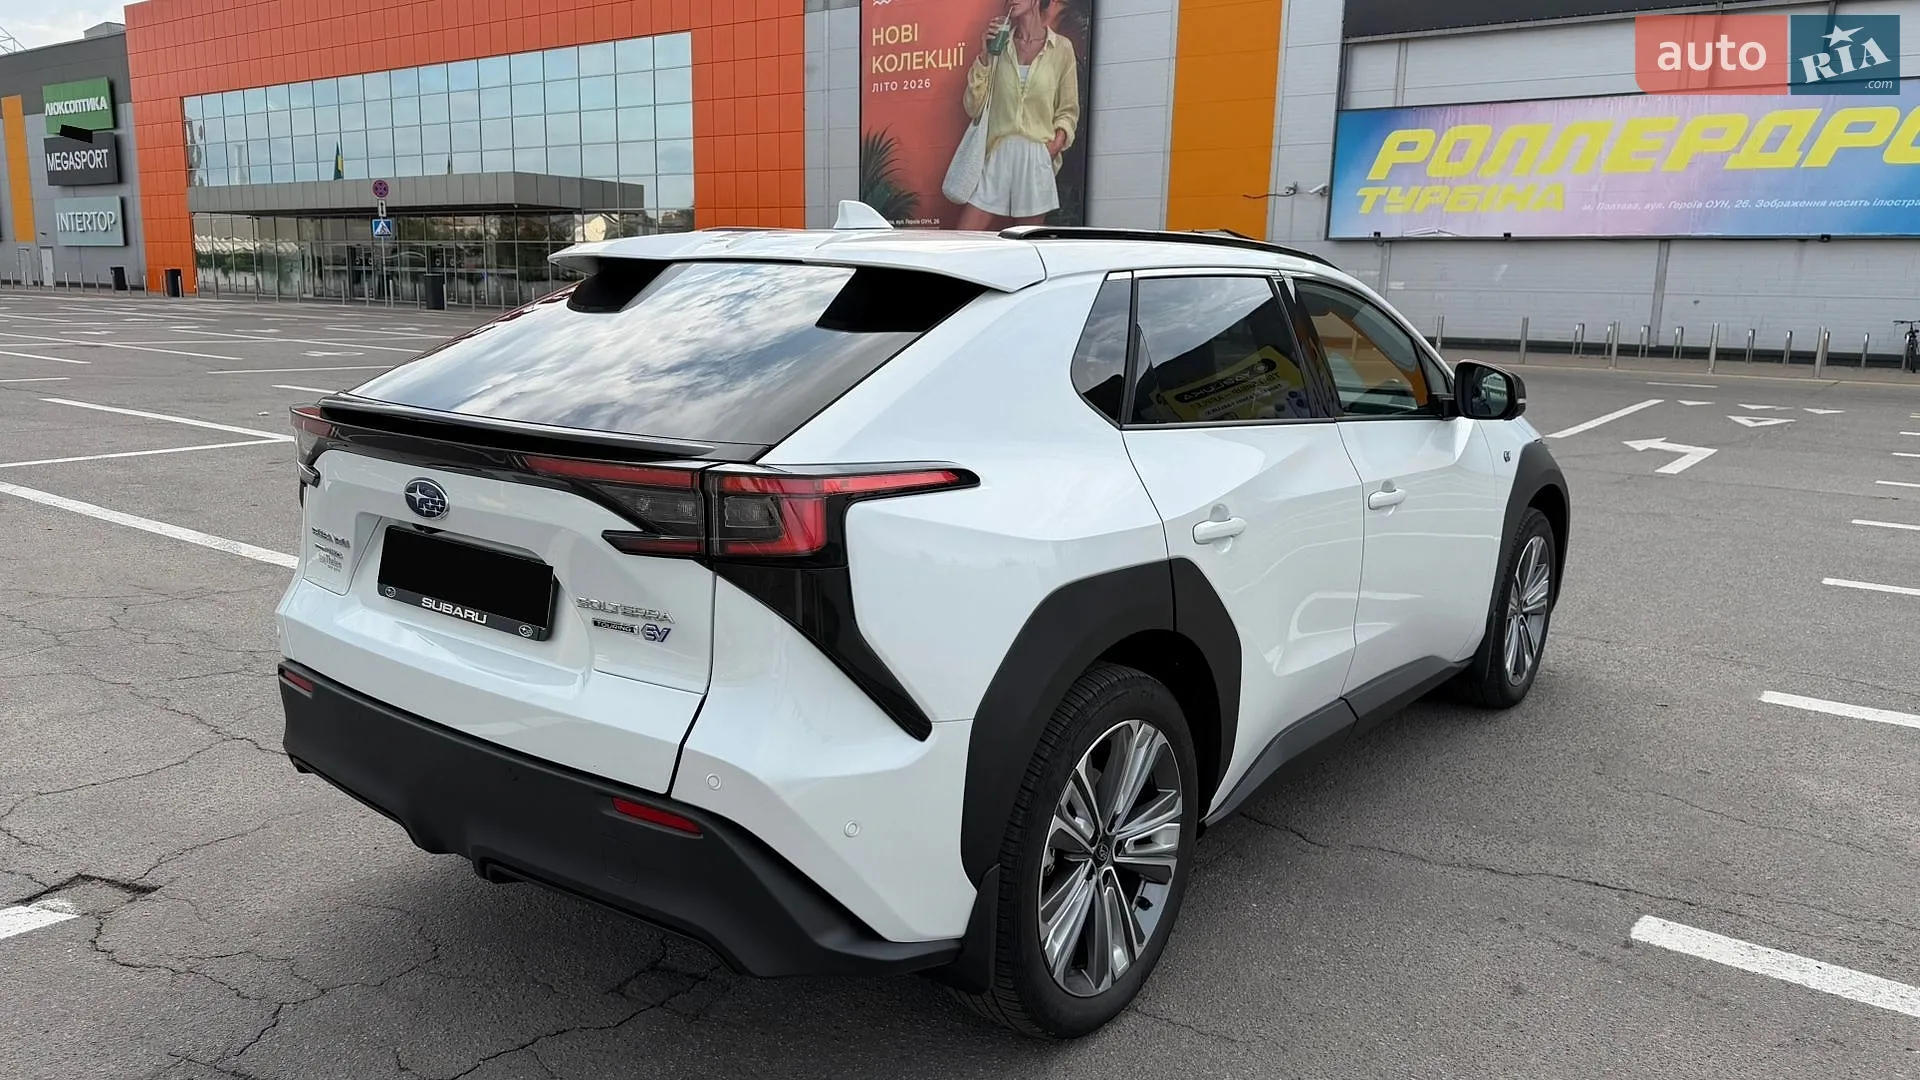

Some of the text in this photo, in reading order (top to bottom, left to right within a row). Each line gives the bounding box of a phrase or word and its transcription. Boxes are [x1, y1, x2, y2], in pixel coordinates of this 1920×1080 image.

[872, 23, 919, 46] НОВІ
[872, 42, 966, 74] КОЛЕКЦІЇ
[872, 78, 931, 93] ЛІТО 2026
[45, 96, 108, 116] ЛЮКСОПТИКА
[47, 149, 109, 172] MEGASPORT
[1356, 182, 1566, 215] ТУРБІНА
[1705, 199, 1731, 210] ОУН,
[1755, 199, 1826, 209] Зображення
[1828, 199, 1870, 208] носить
[56, 210, 116, 233] INTERTOP
[421, 597, 487, 624] SUBARU
[577, 597, 674, 624] SOLTERRA
[596, 620, 633, 633] TOURING
